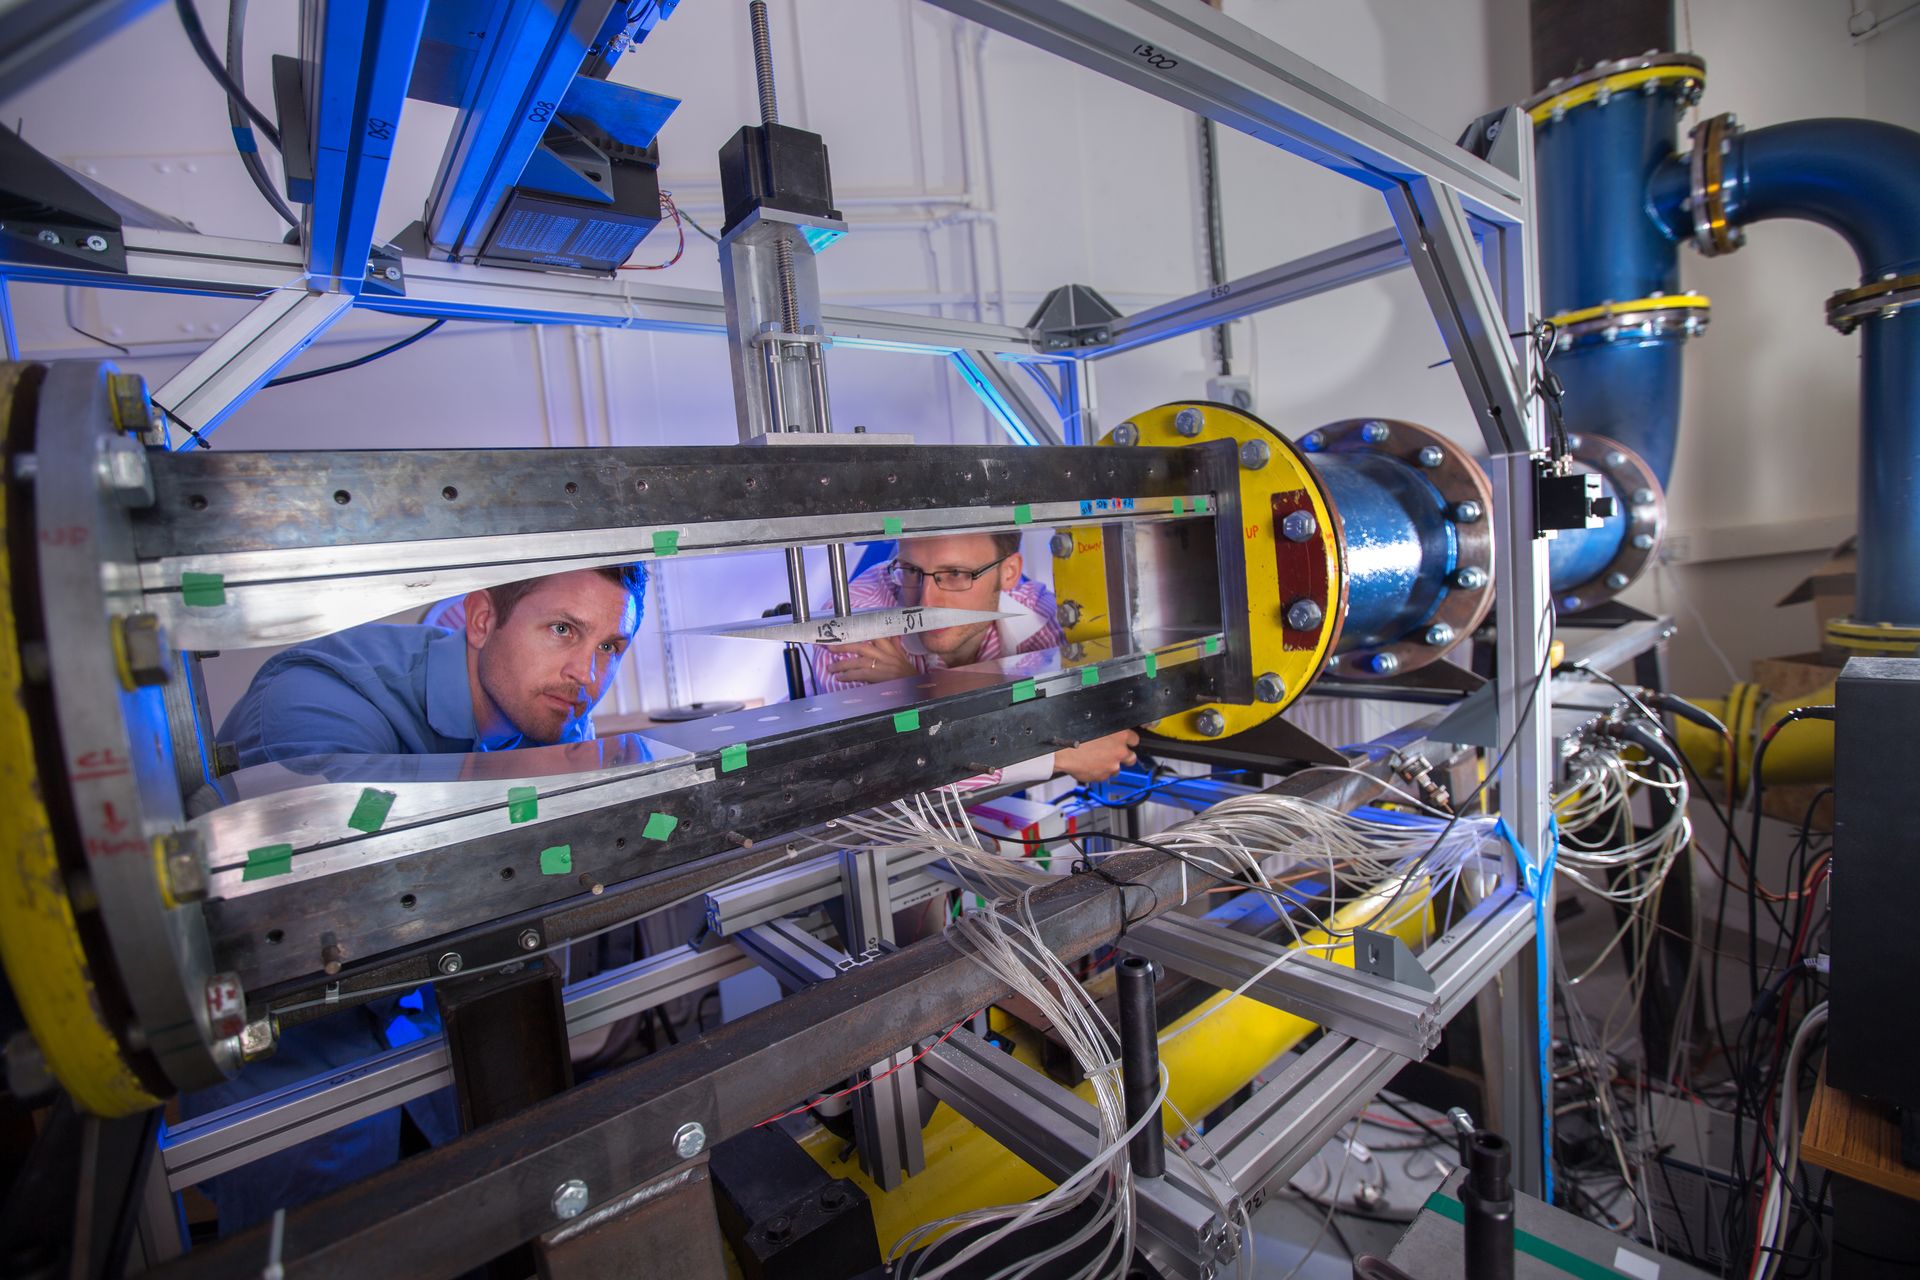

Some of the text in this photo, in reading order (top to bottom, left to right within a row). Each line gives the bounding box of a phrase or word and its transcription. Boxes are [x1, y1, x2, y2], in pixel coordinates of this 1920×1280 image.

[1133, 44, 1178, 69] 1300
[528, 101, 555, 122] 800
[1246, 525, 1259, 539] UP
